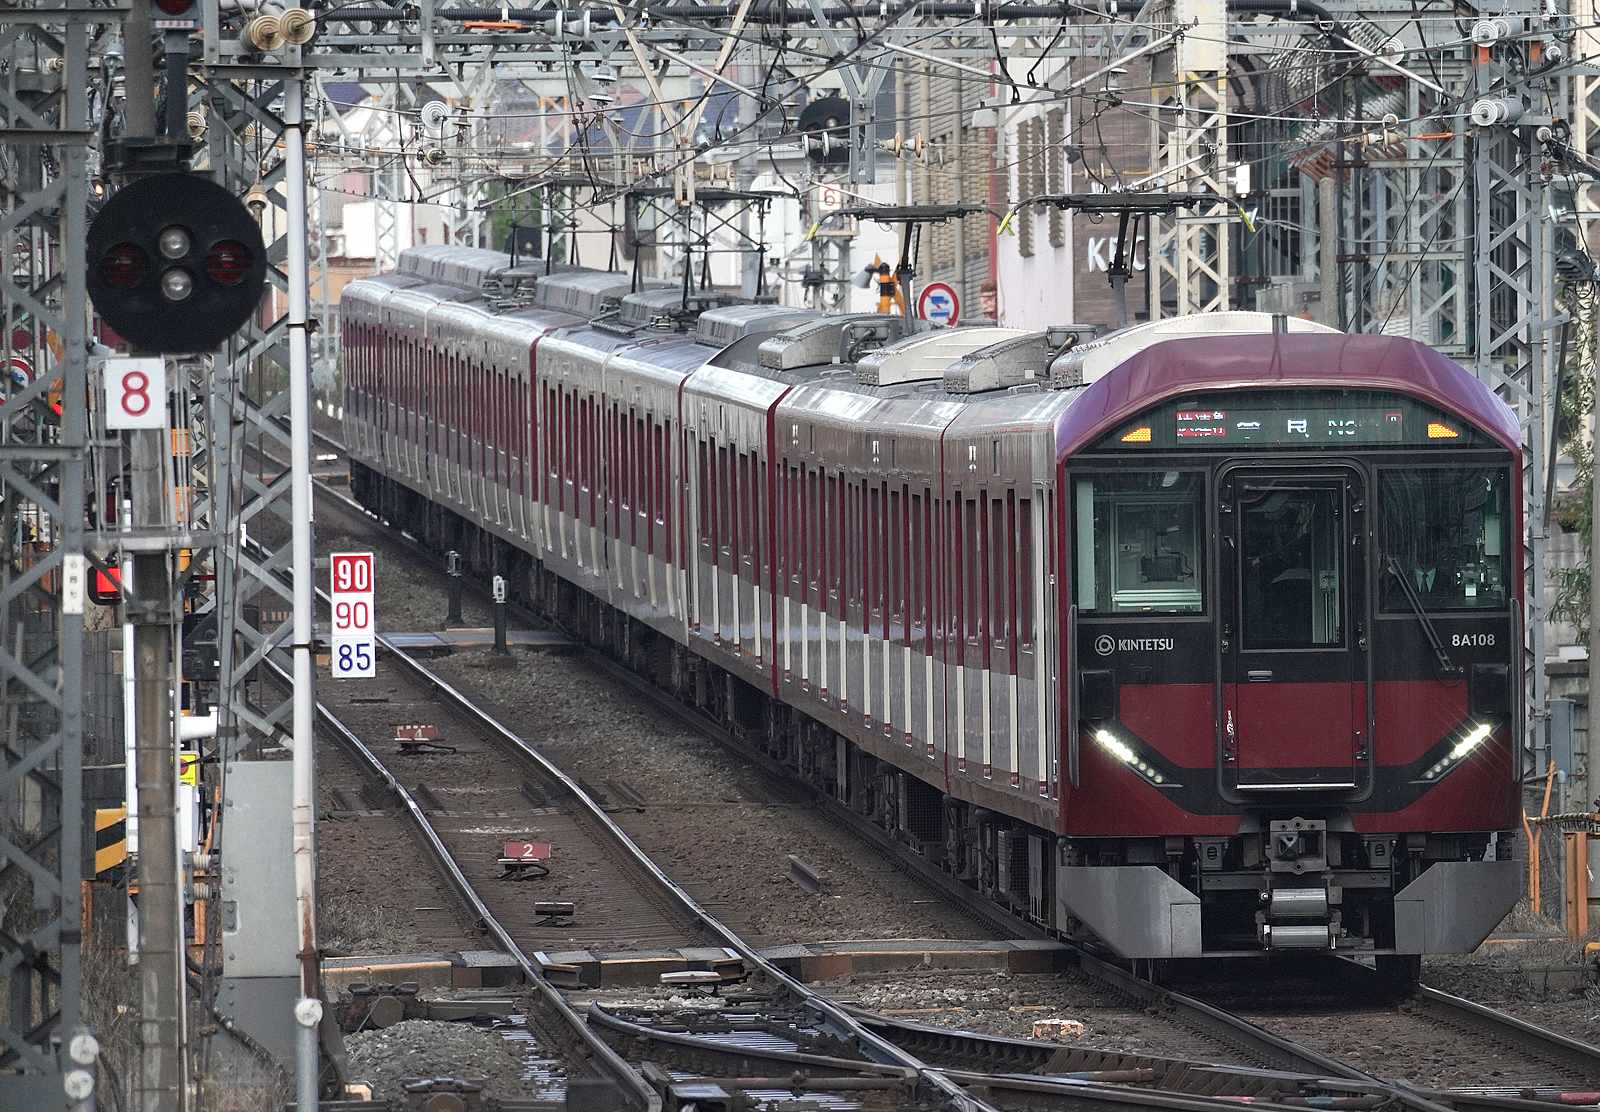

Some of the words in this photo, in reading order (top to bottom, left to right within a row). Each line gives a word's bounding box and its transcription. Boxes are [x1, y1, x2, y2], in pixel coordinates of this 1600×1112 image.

[824, 189, 835, 206] 6
[121, 371, 150, 417] 8
[338, 560, 368, 590] 90
[336, 602, 369, 629] 90
[1118, 639, 1174, 651] KINTETSU
[1452, 634, 1495, 646] 8A108
[339, 643, 371, 672] 85
[414, 728, 422, 738] 4
[523, 844, 533, 857] 2
